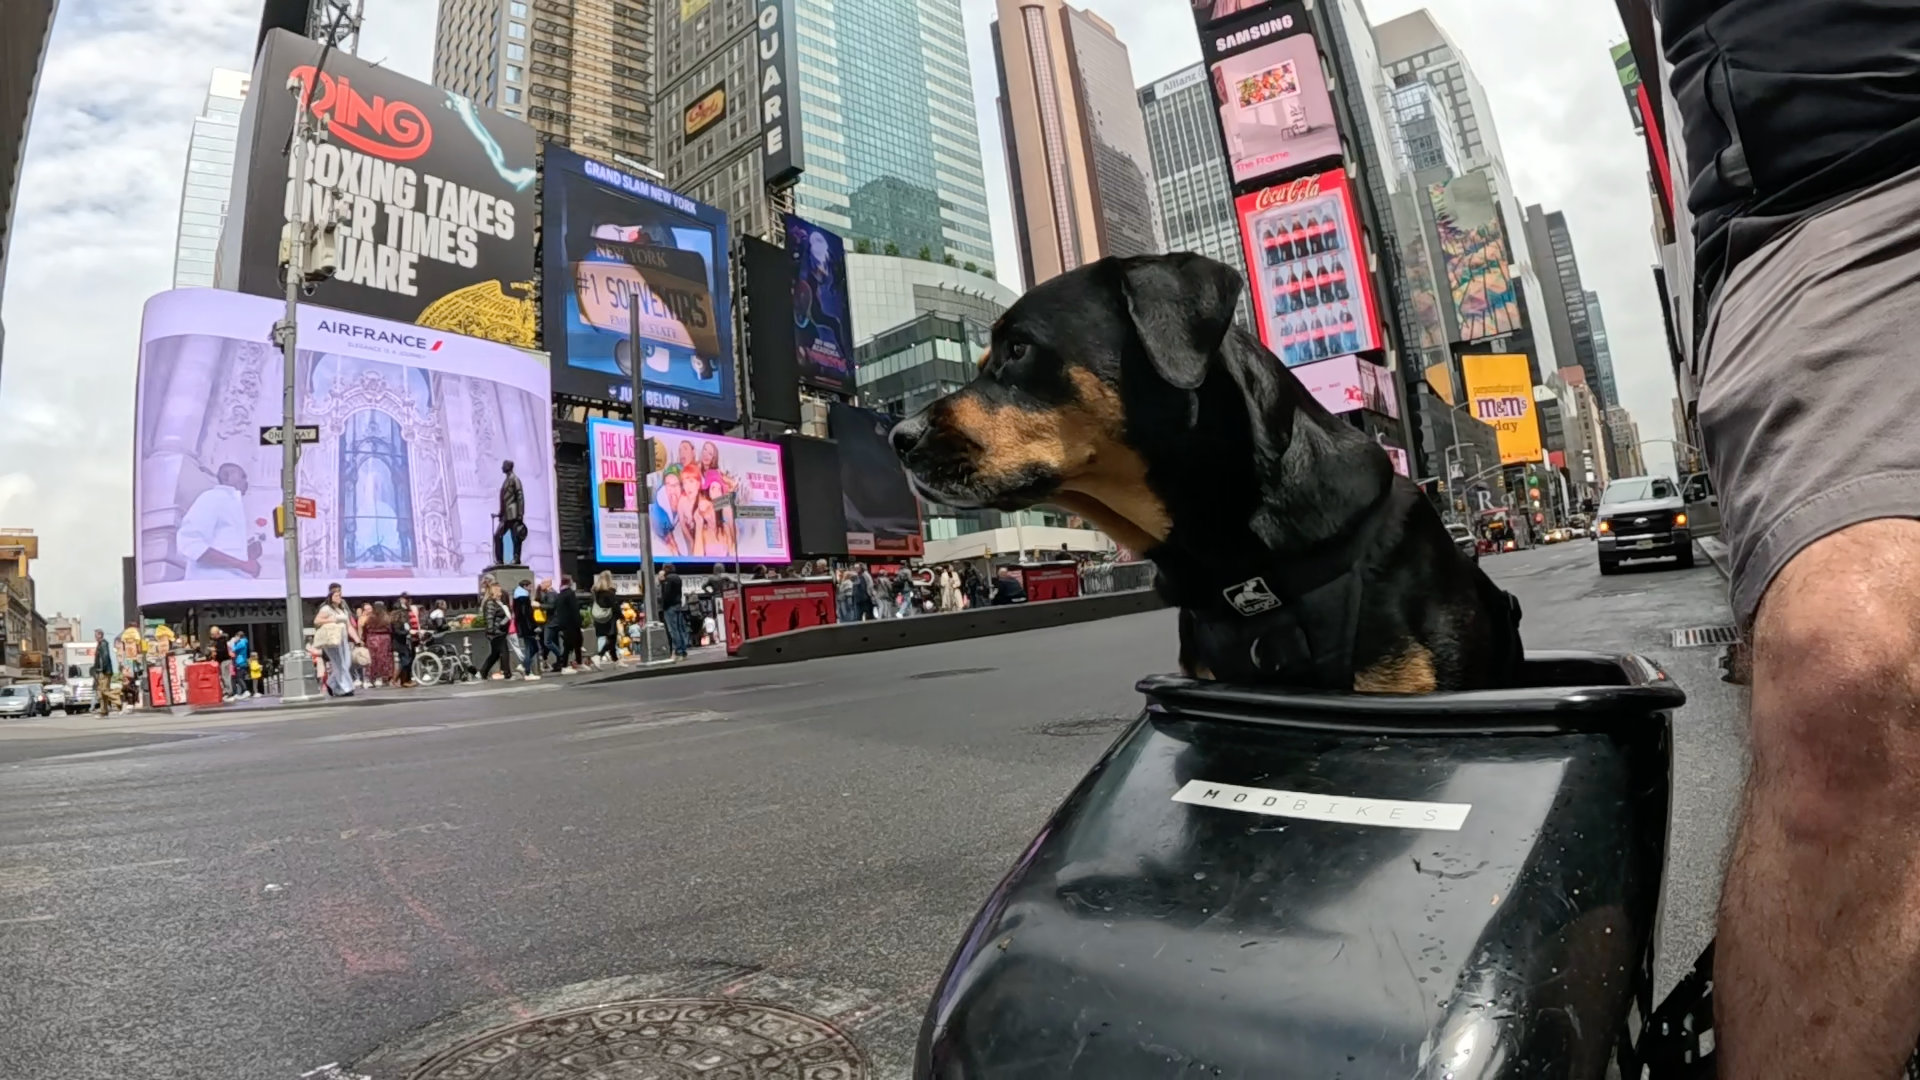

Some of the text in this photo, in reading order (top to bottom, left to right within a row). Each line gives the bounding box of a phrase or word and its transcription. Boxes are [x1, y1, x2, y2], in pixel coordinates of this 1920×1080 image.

[1215, 14, 1294, 52] SAMSUNG
[759, 0, 783, 155] QUARE
[1162, 73, 1198, 93] Allianz
[1236, 150, 1290, 172] The Frame
[287, 141, 515, 240] BOXING TAKES
[584, 160, 622, 188] GRAND
[623, 173, 649, 198] SLAM
[650, 187, 672, 207] NEW
[673, 192, 697, 215] YORK
[385, 204, 478, 269] TIMES
[596, 243, 668, 268] NEW YORK
[646, 390, 680, 409] BELOW
[1495, 420, 1518, 433] day
[600, 431, 617, 458] THE
[168, 656, 181, 703] CHICAGO
